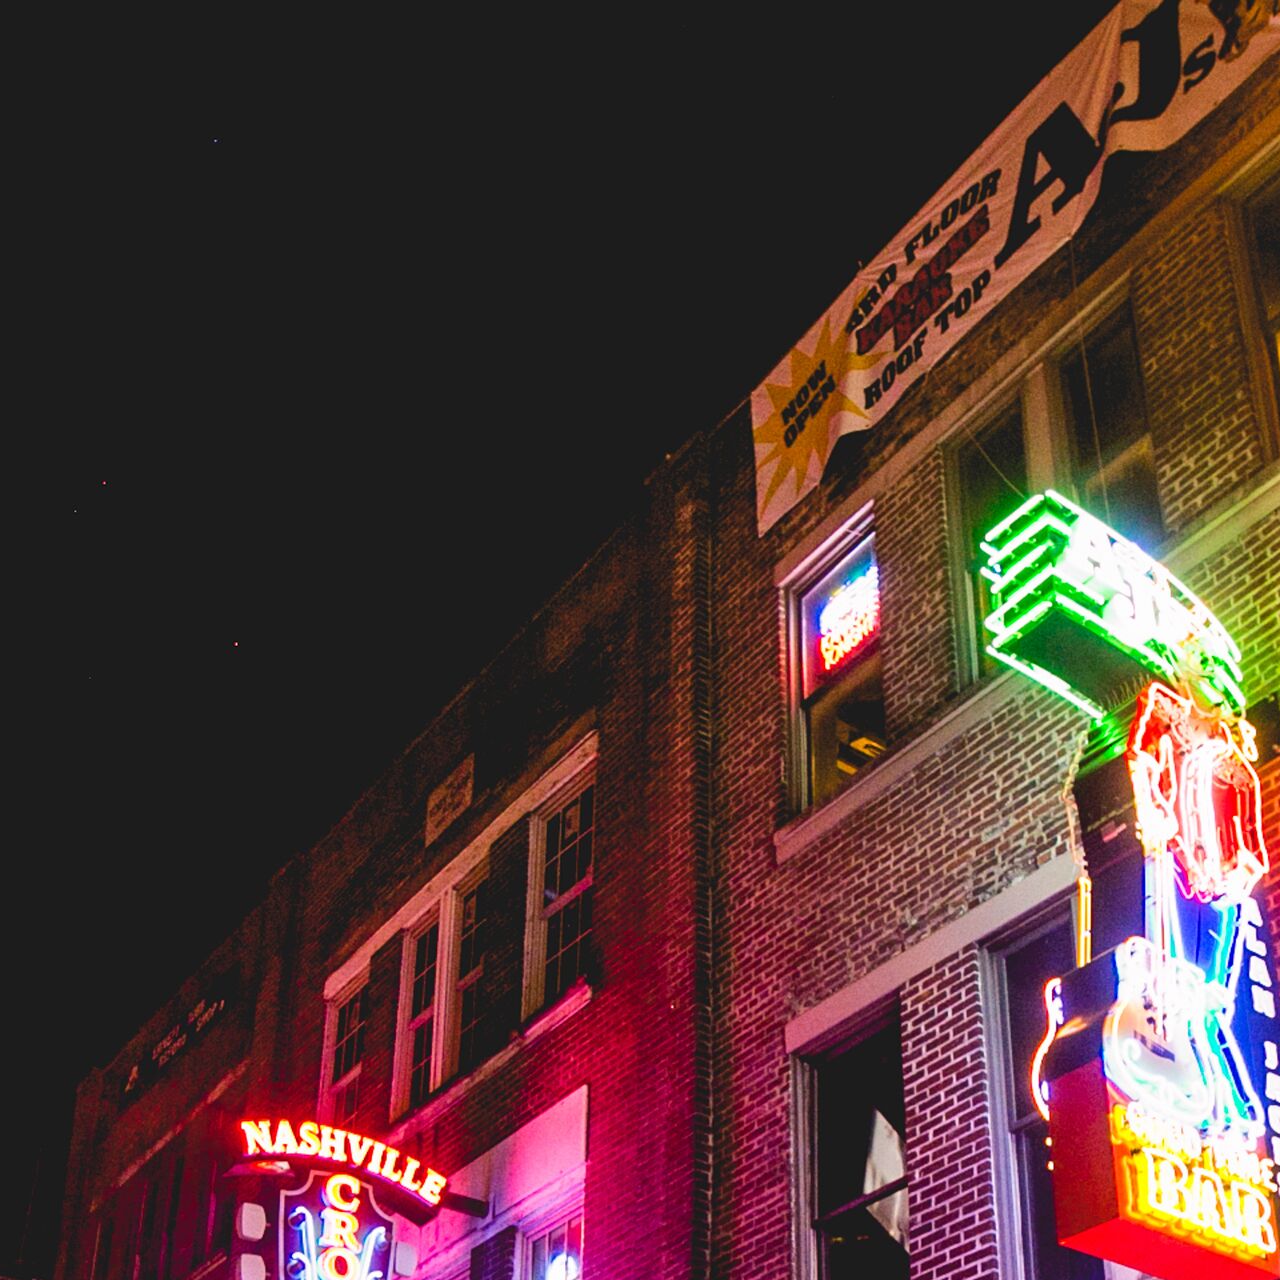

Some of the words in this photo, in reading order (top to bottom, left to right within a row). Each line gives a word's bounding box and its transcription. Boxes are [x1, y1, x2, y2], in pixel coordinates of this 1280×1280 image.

[845, 263, 898, 334] 3RD
[904, 168, 1002, 266] FLOOR
[855, 203, 991, 356] KARAOKE
[863, 327, 928, 410] ROOF
[934, 269, 992, 335] TOP
[892, 272, 954, 352] BAR
[780, 359, 828, 426] NOW
[783, 374, 837, 449] OPEN
[1242, 893, 1276, 1020] ALAN
[240, 1118, 448, 1206] NASHVILLE
[1142, 1146, 1278, 1254] BAR
